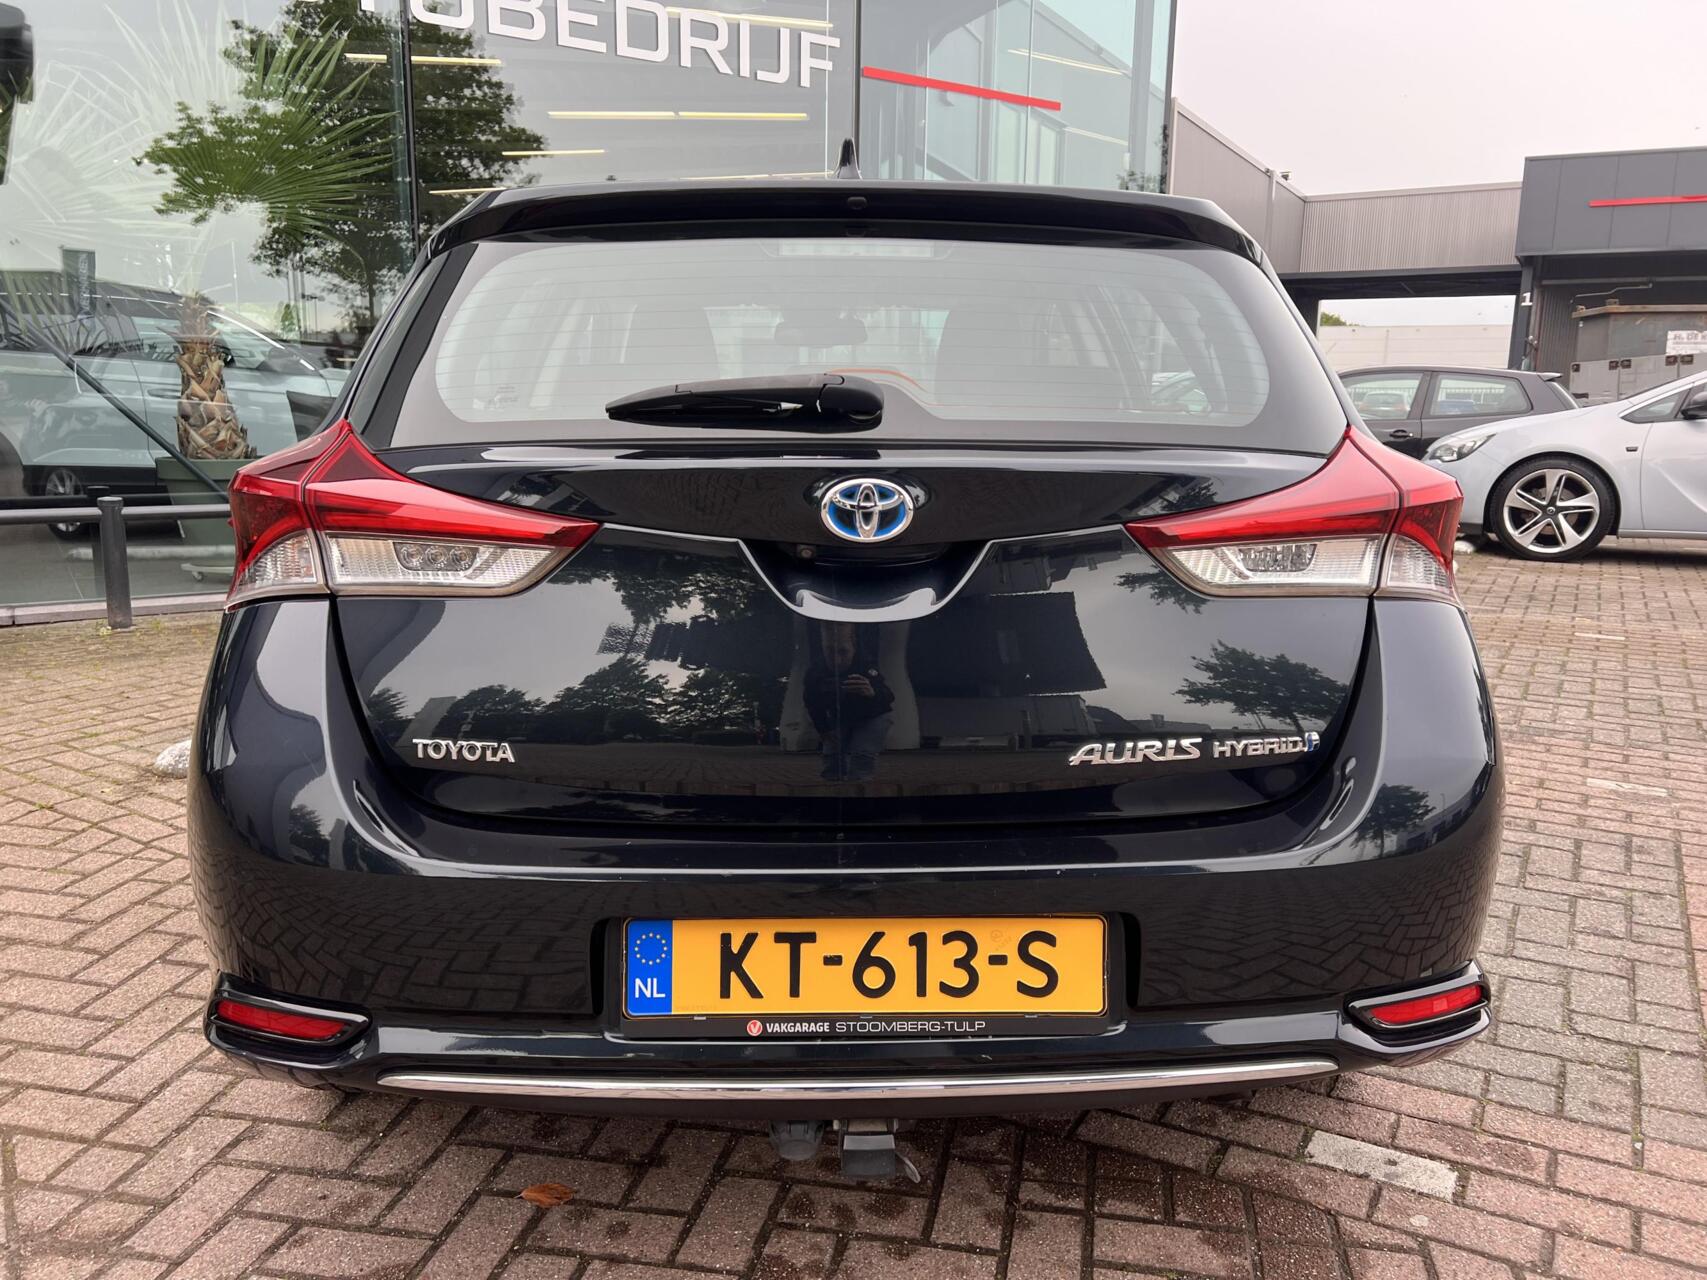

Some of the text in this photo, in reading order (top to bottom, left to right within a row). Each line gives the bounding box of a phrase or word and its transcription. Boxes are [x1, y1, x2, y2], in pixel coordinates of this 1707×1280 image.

[361, 0, 841, 88] OBEDRIJF
[1521, 291, 1533, 306] 1
[412, 739, 515, 762] TOYOTA
[1069, 736, 1306, 766] AURIS HYBRID
[719, 930, 1060, 1000] KT-613-S
[635, 977, 666, 998] NL
[766, 1022, 830, 1033] VAKGARAGE
[835, 1021, 986, 1033] STOOMBERG-TULP
